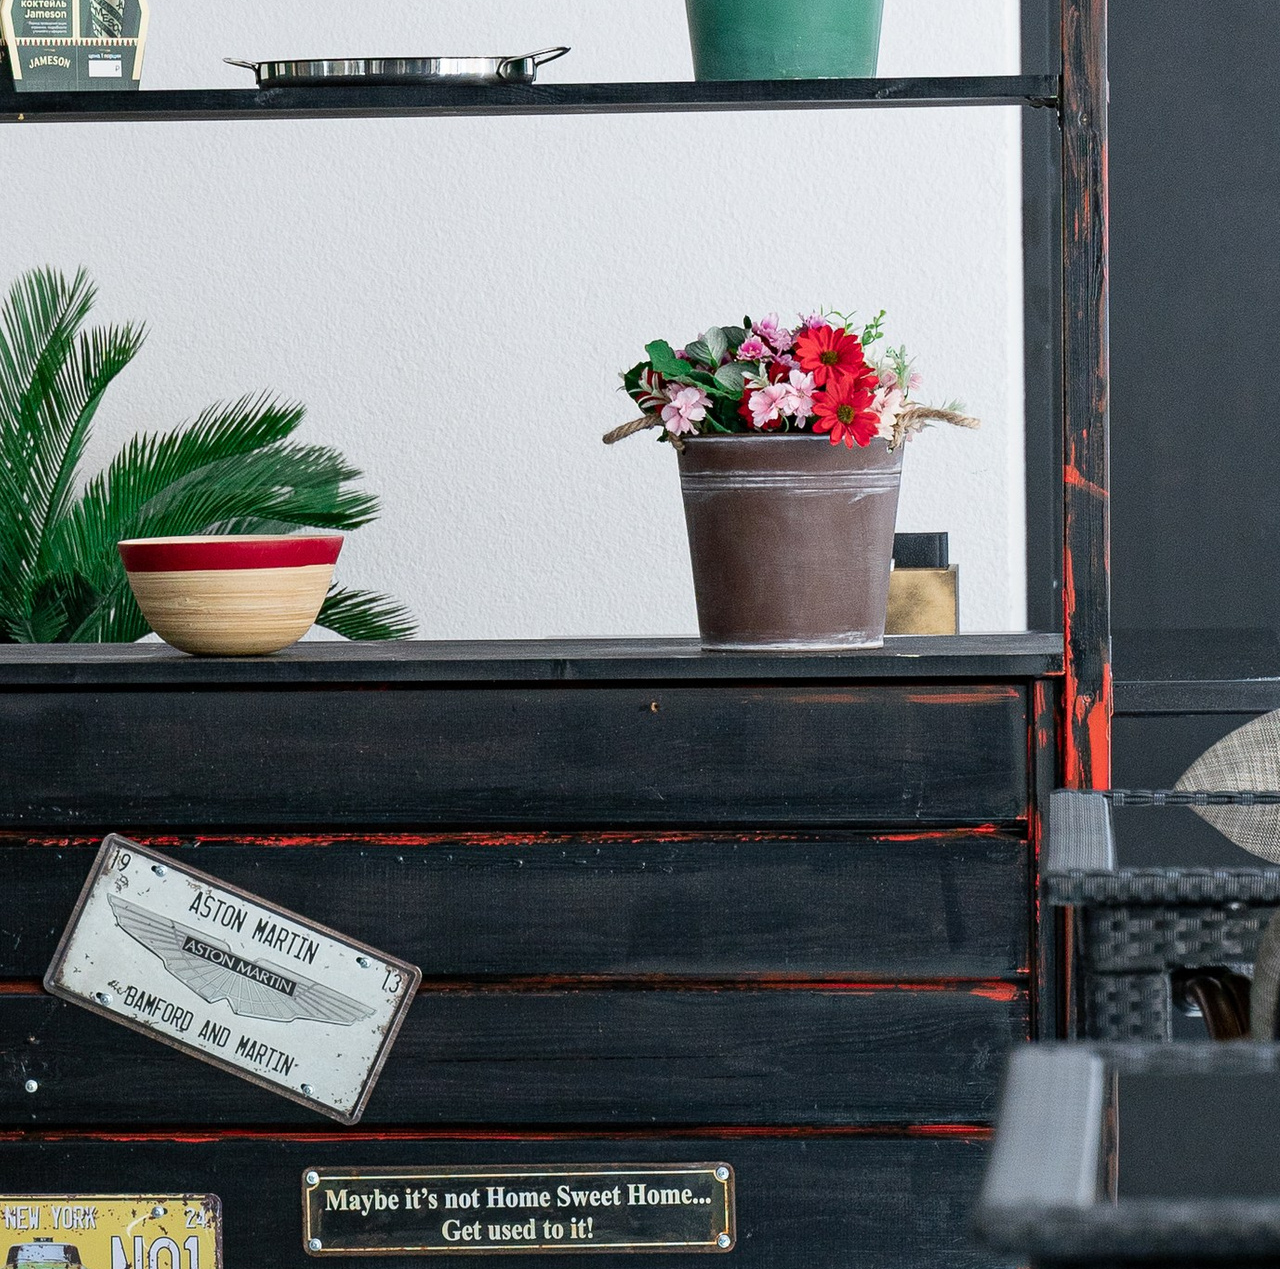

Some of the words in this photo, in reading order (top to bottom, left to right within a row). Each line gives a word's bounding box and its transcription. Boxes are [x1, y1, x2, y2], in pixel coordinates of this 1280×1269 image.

[25, 9, 67, 18] Jameson
[29, 55, 71, 69] JAMESON
[111, 849, 131, 872] 19
[188, 891, 248, 933] ASTON
[251, 917, 320, 965] MARTIN
[184, 939, 235, 969] ASTON
[236, 960, 292, 994] MARTIN
[381, 970, 402, 993] 13
[123, 986, 194, 1032] BAMFORD
[197, 1019, 231, 1048] AND
[234, 1034, 295, 1077] MARTIN
[324, 1188, 399, 1217] Maybe
[405, 1187, 438, 1210] it’s
[445, 1188, 481, 1209] not
[486, 1186, 551, 1208] Home
[557, 1184, 621, 1208] Sweet
[627, 1183, 712, 1206] Home...
[4, 1206, 40, 1230] NEW
[51, 1206, 97, 1230] YORK
[441, 1219, 482, 1241] Get
[488, 1218, 536, 1240] used
[542, 1219, 564, 1240] to
[570, 1217, 594, 1239] it!
